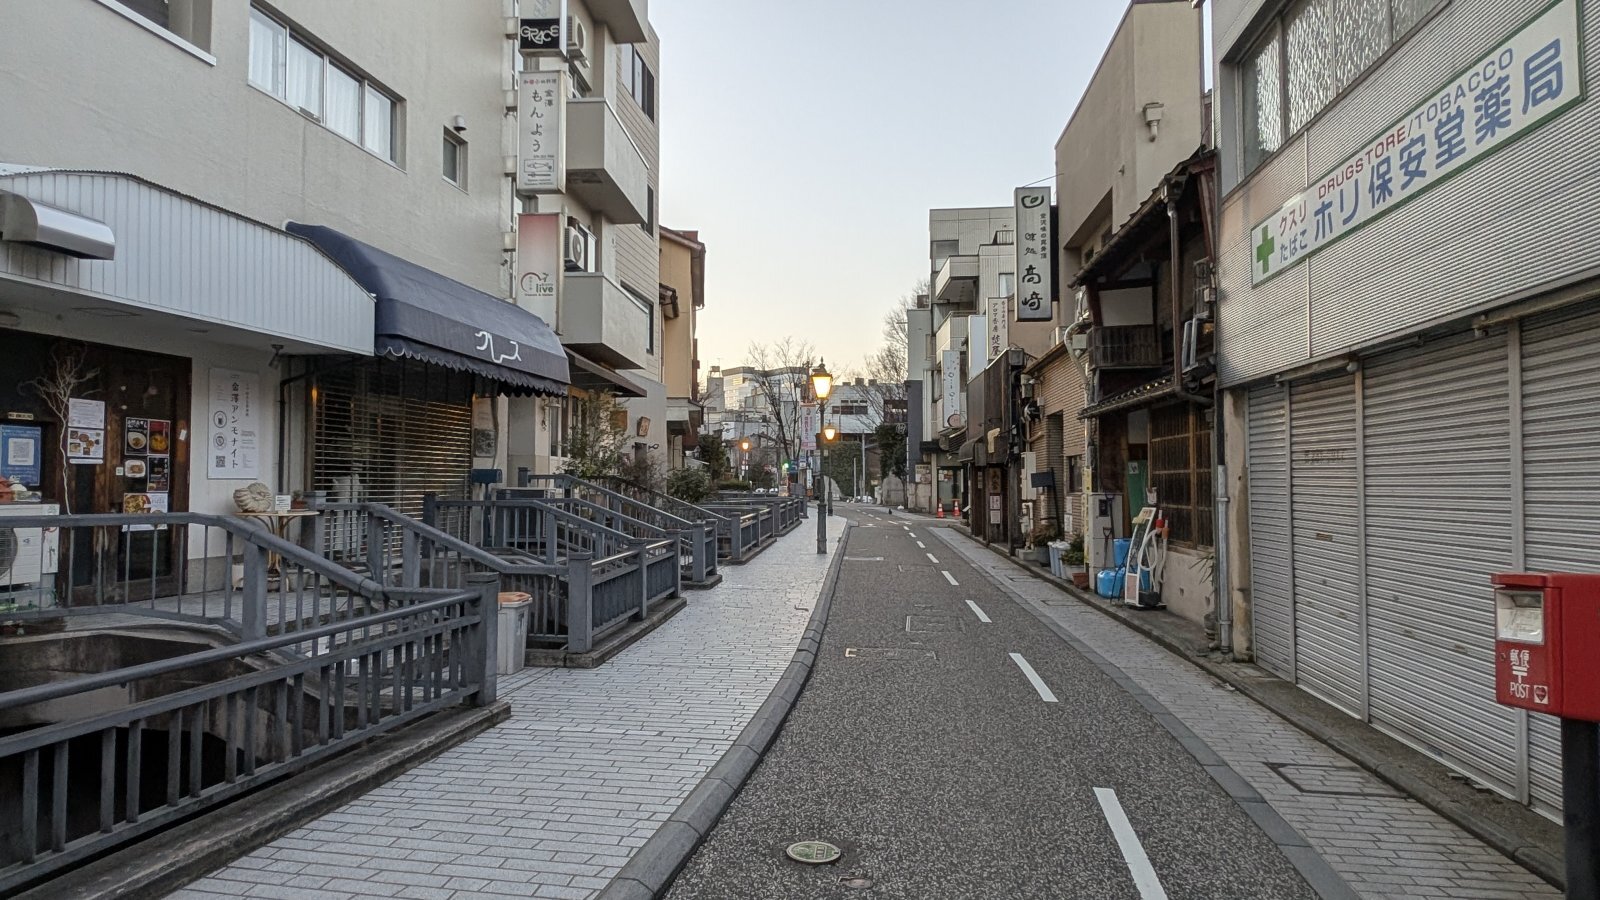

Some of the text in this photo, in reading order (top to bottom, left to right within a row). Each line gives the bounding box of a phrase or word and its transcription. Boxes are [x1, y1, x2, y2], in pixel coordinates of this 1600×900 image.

[520, 24, 560, 45] GRACE
[530, 89, 544, 153] もんよう
[1317, 48, 1514, 201] DRUGSTORE/TOBACCO
[1313, 38, 1564, 241] ホリ保安堂薬局
[1279, 199, 1307, 237] クスリ
[1280, 228, 1309, 264] たばこ
[536, 283, 554, 294] live
[1510, 649, 1530, 668] 郵便
[1510, 681, 1531, 699] POST
